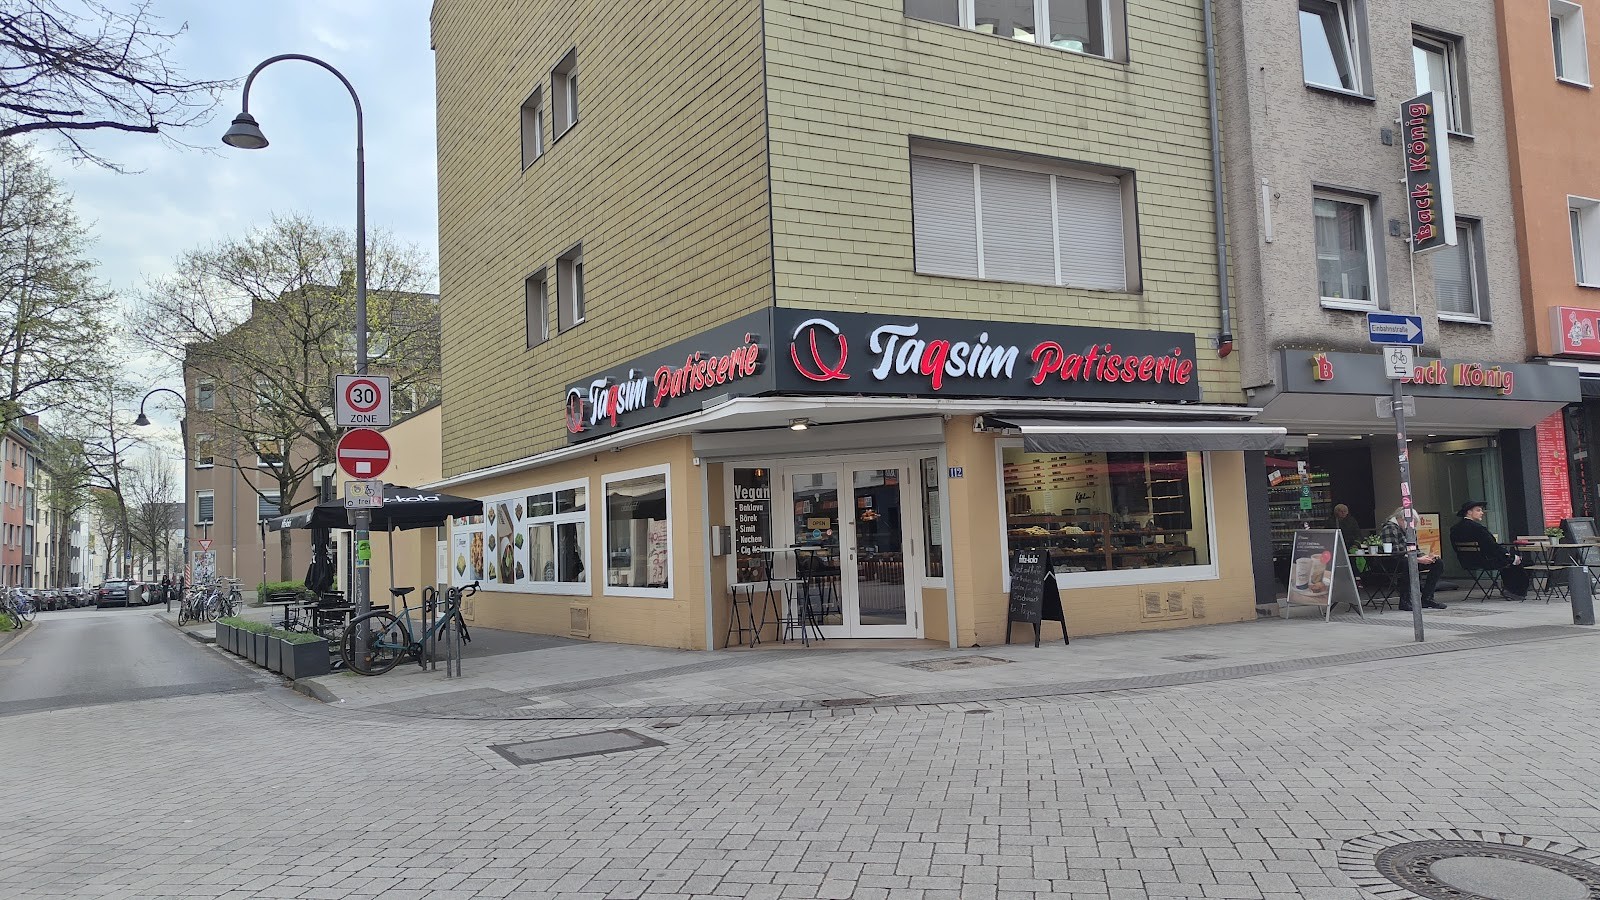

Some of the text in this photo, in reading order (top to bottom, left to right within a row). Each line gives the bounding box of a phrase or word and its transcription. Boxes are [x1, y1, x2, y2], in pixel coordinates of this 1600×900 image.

[1405, 103, 1433, 245] Back König
[1371, 324, 1409, 333] Einbahnstraße
[869, 323, 1019, 391] Taqsim
[1030, 340, 1193, 386] Patisserie
[589, 368, 648, 427] Taqsim
[653, 332, 758, 408] Patisserie
[1400, 360, 1514, 395] ack König
[353, 388, 374, 404] 30
[350, 414, 378, 423] ZONE
[950, 467, 963, 477] 112
[735, 485, 770, 501] Vegan
[739, 503, 764, 512] Baklava
[739, 514, 757, 522] Börek
[739, 525, 756, 533] Simit
